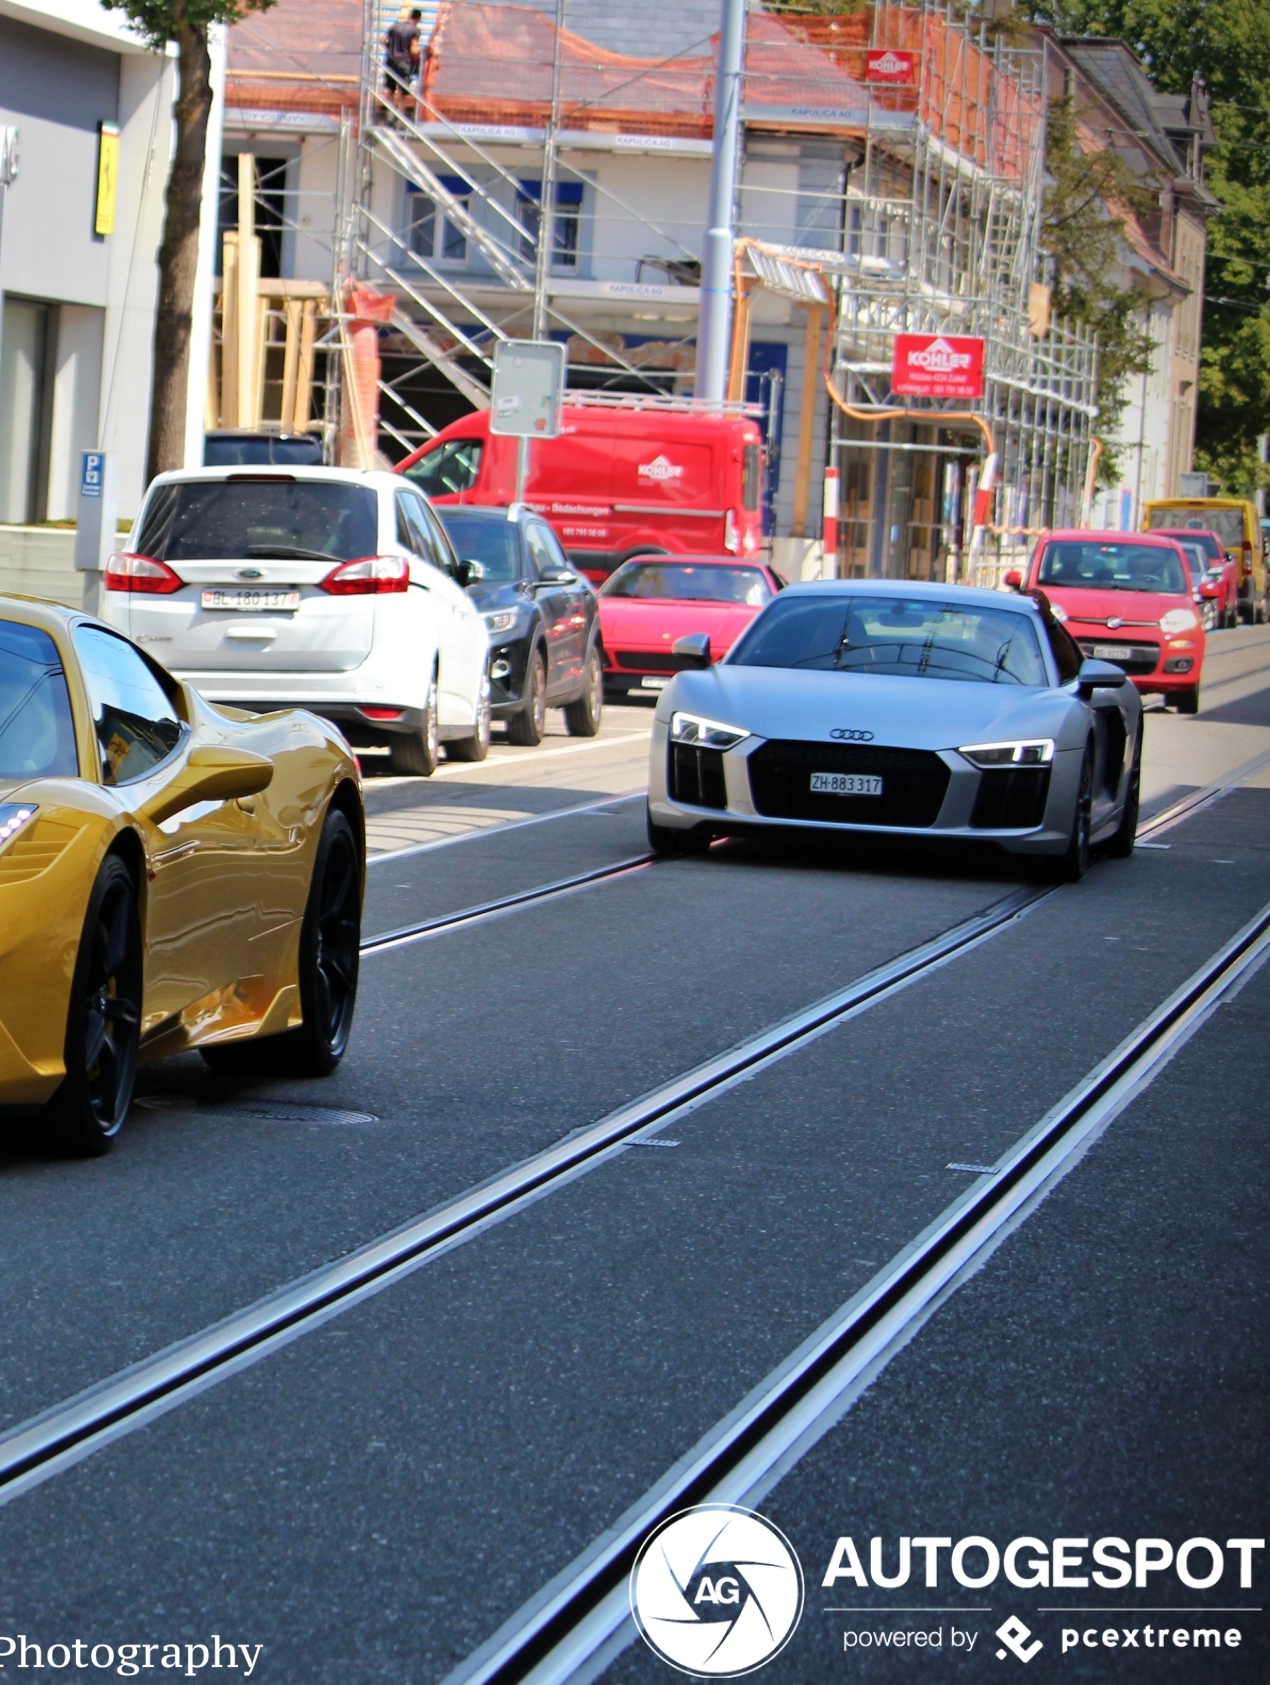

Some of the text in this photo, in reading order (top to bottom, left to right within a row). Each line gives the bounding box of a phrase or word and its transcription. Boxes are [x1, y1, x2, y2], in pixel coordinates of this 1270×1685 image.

[790, 108, 851, 118] KAPULICA AG
[461, 126, 516, 136] KAPULICA AG
[616, 136, 671, 147] KAPULICA AG
[609, 284, 649, 294] KAPULICA
[907, 350, 972, 370] KOHLER
[87, 455, 99, 471] P
[638, 464, 683, 478] KOHLER
[551, 503, 610, 517] Bedachungen
[263, 592, 289, 606] 137
[856, 778, 882, 792] 317
